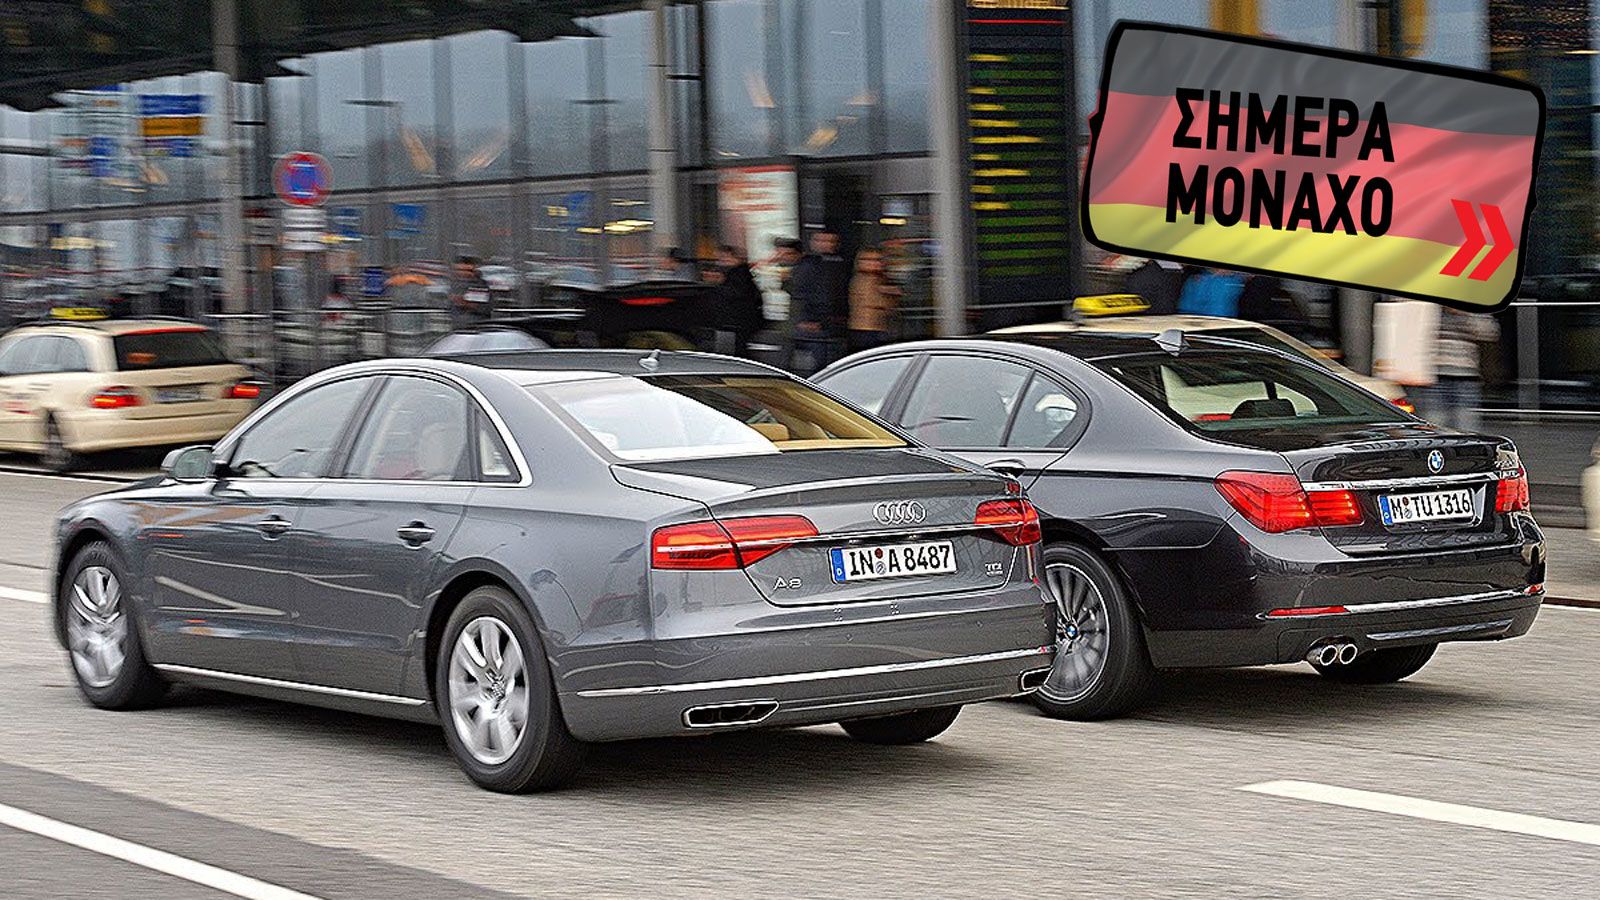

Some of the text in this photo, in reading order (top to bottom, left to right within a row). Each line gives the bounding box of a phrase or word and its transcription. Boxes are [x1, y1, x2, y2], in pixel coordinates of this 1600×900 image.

[1390, 493, 1471, 519] M TU 1316
[849, 545, 950, 576] IN A 8487
[773, 575, 802, 590] A8
